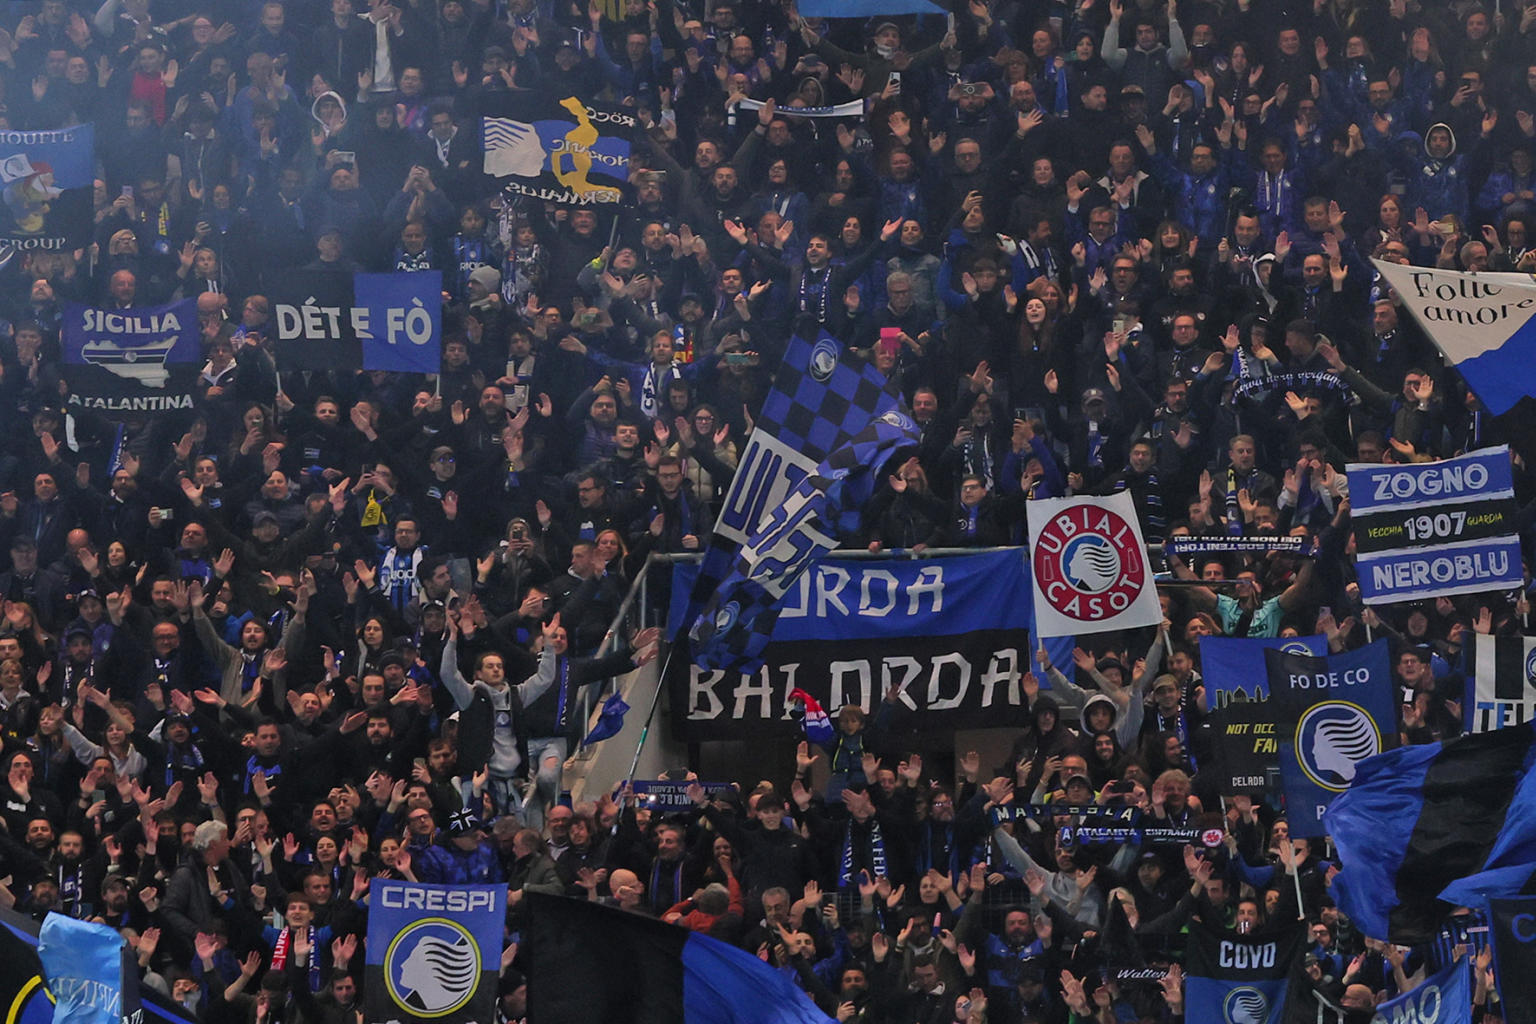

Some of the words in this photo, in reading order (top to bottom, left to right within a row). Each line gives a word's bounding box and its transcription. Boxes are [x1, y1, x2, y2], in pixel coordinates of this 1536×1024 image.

[82, 308, 182, 334] SICILIA
[275, 296, 340, 341] DÉT
[349, 306, 374, 339] E
[386, 296, 433, 345] FÒ
[1372, 462, 1489, 501] ZOGNO
[1367, 524, 1403, 538] VECCHIA
[1404, 511, 1468, 541] 1907
[1467, 512, 1504, 526] GUARDIA
[1372, 551, 1509, 591] NEROBLU
[1289, 673, 1310, 689] FO
[1315, 671, 1340, 689] DE
[1343, 667, 1371, 684] CO
[1225, 723, 1250, 735] NOT
[381, 885, 498, 914] CRESPI
[1218, 940, 1277, 969] COVO
